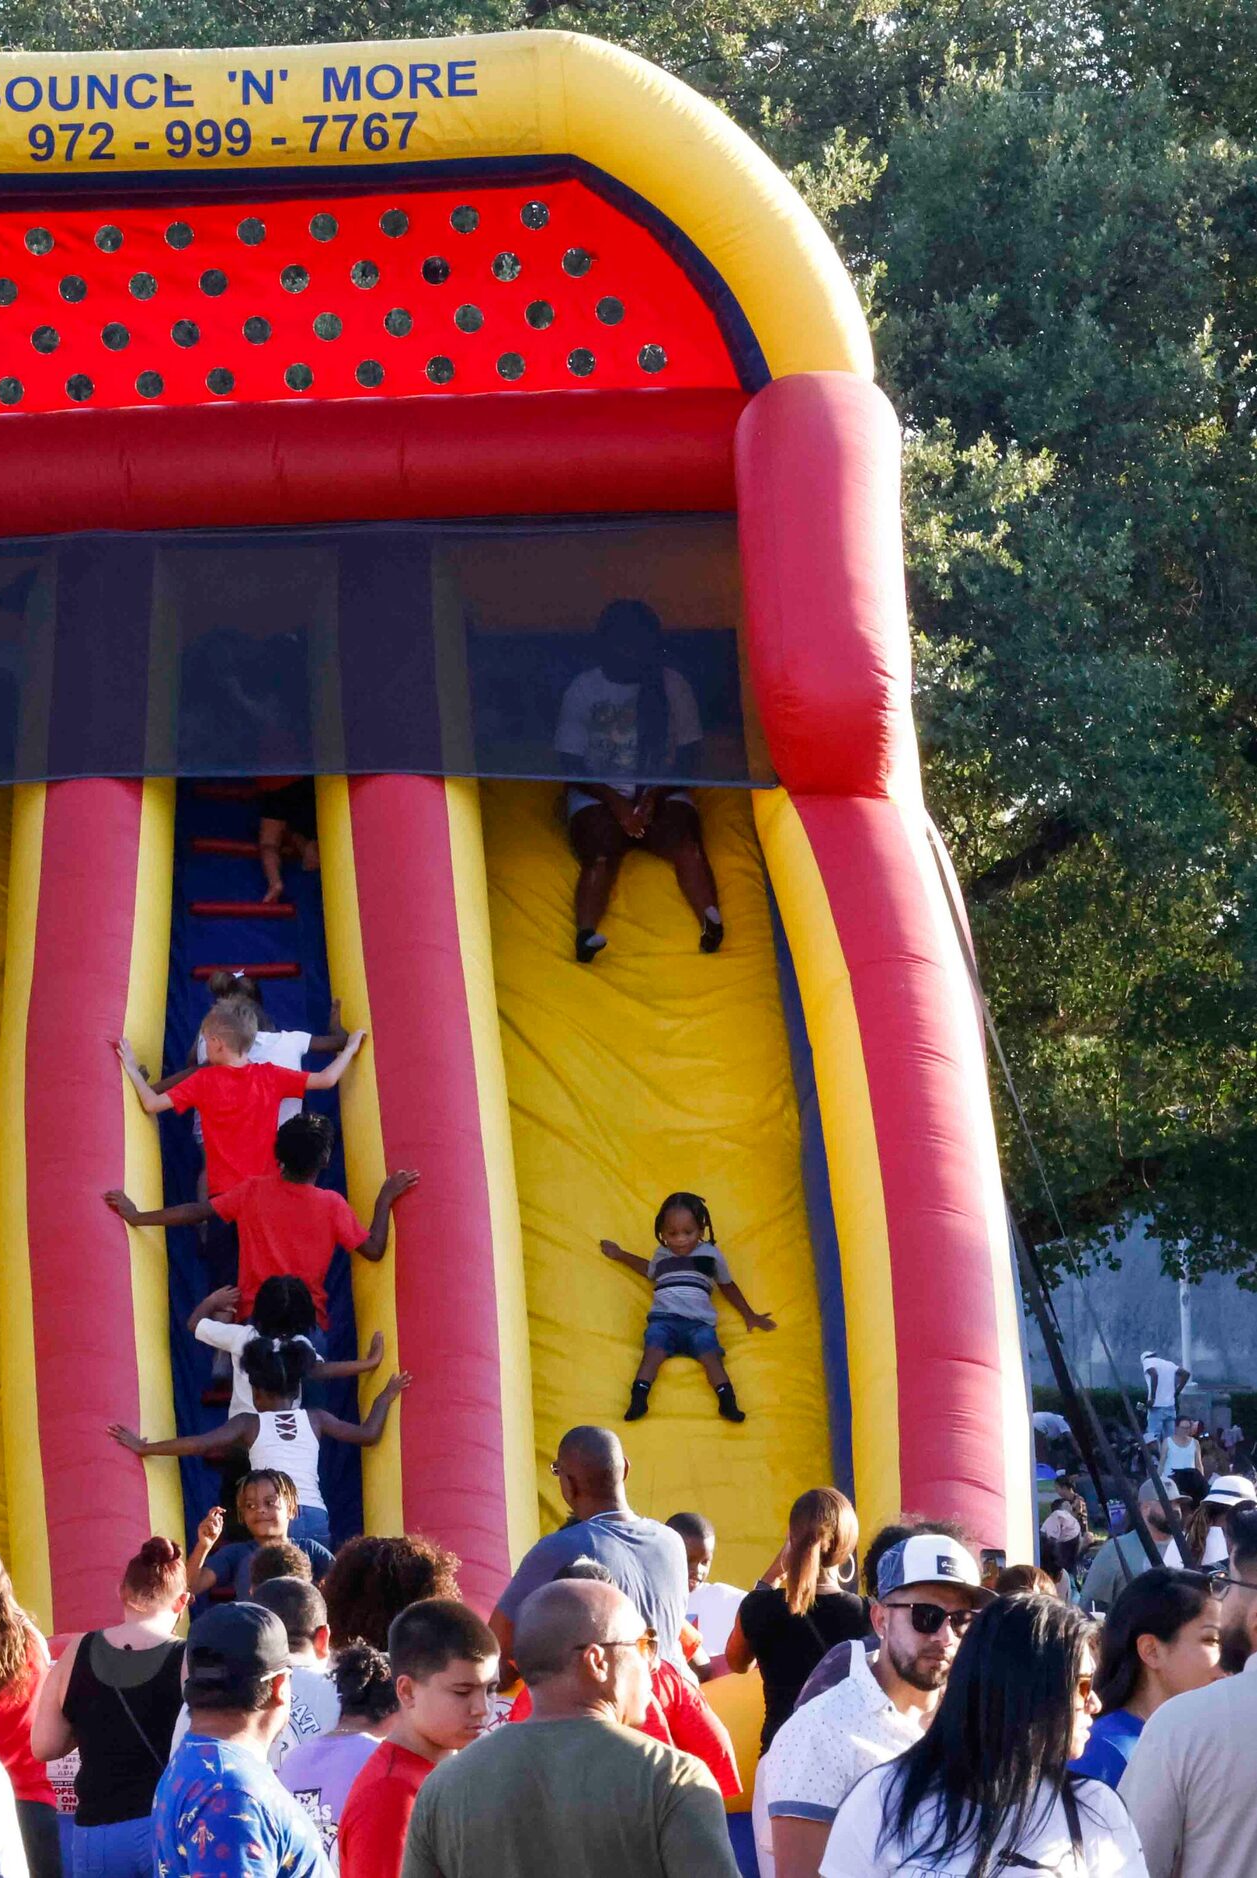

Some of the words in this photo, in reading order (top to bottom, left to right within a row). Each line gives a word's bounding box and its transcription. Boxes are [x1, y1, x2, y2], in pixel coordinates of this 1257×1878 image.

[228, 69, 288, 106] 'N'
[323, 60, 478, 102] MORE
[28, 122, 116, 161] 972
[165, 117, 252, 158] 999
[302, 112, 419, 153] 7767
